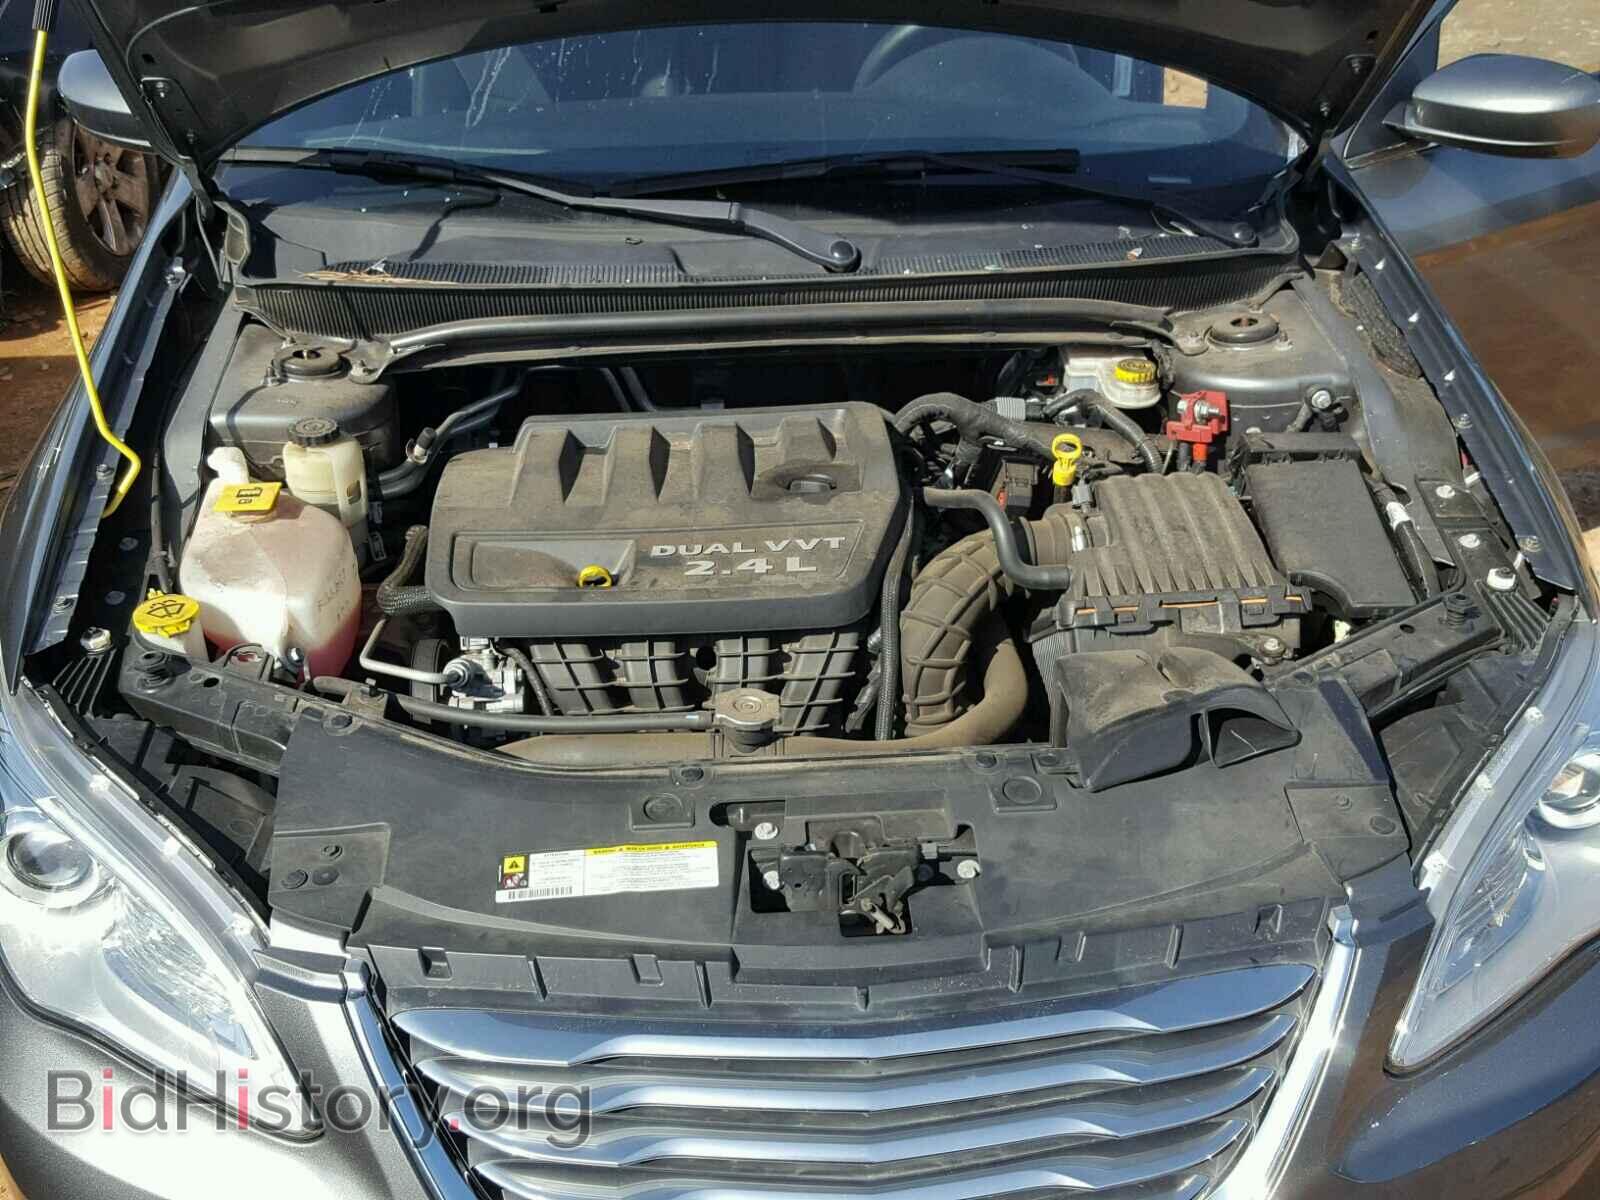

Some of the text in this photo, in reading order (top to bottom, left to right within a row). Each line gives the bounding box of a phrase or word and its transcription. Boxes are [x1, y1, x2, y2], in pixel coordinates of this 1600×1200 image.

[650, 536, 845, 557] DUAL VVT
[684, 556, 817, 575] 2.4 L
